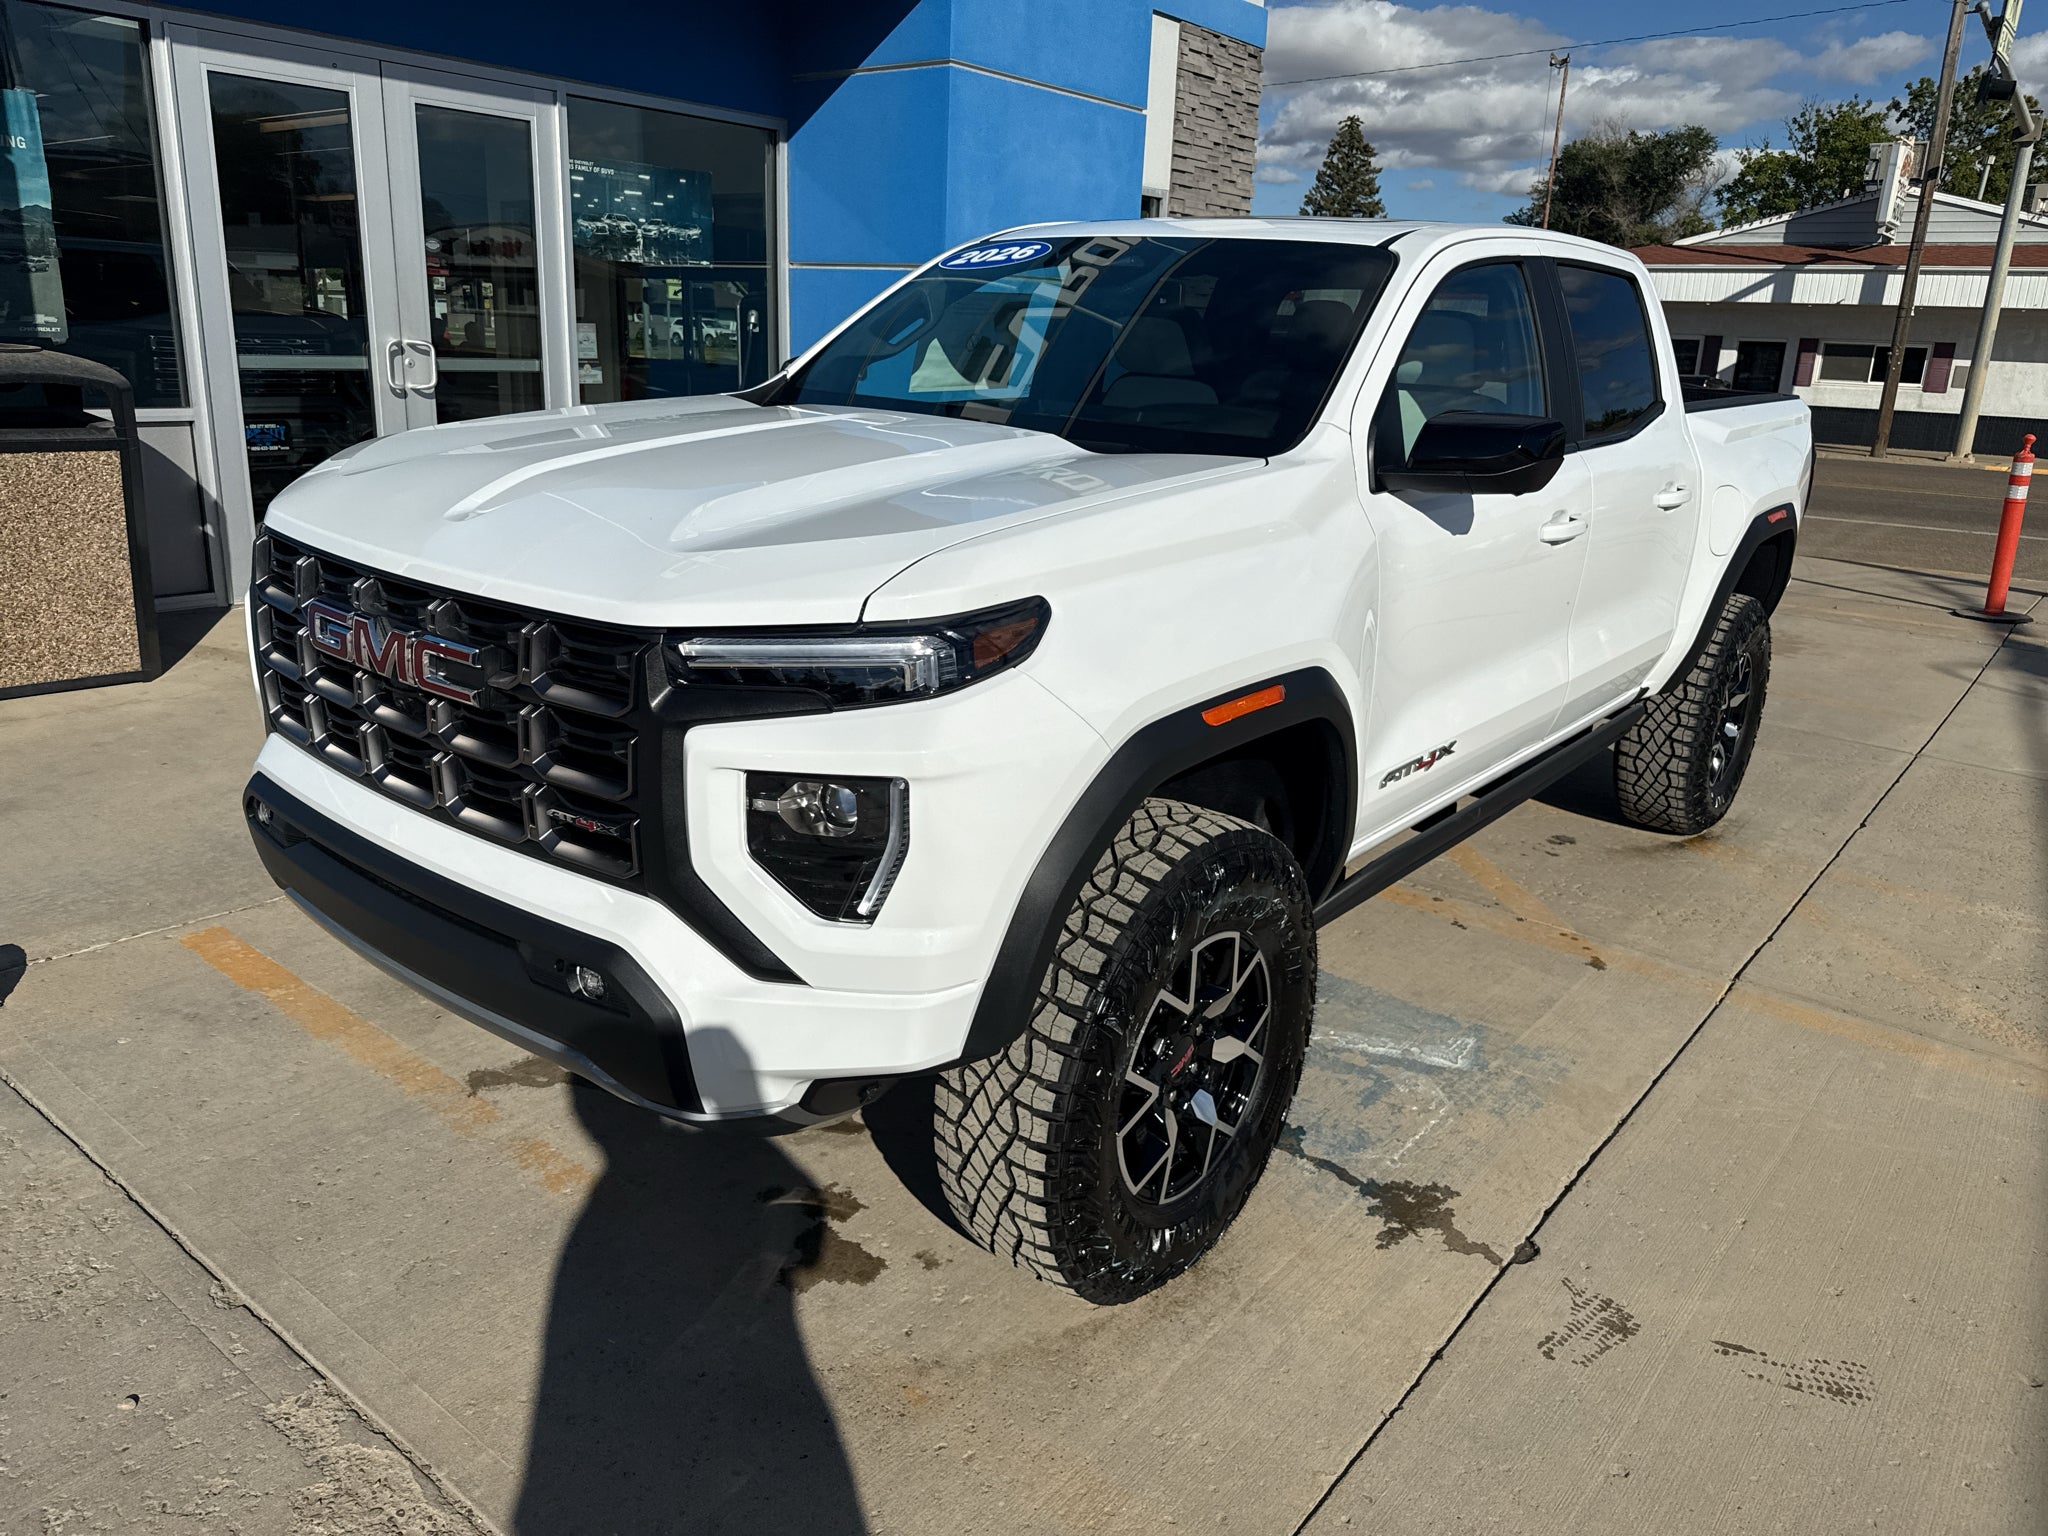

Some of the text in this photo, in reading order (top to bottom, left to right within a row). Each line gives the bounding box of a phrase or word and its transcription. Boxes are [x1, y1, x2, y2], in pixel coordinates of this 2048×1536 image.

[575, 164, 593, 172] FAMILY
[946, 245, 1042, 266] 2026
[308, 600, 483, 709] GMC
[1378, 740, 1458, 790] AT4X
[546, 808, 619, 836] AT4X
[1170, 1043, 1195, 1078] GMC
